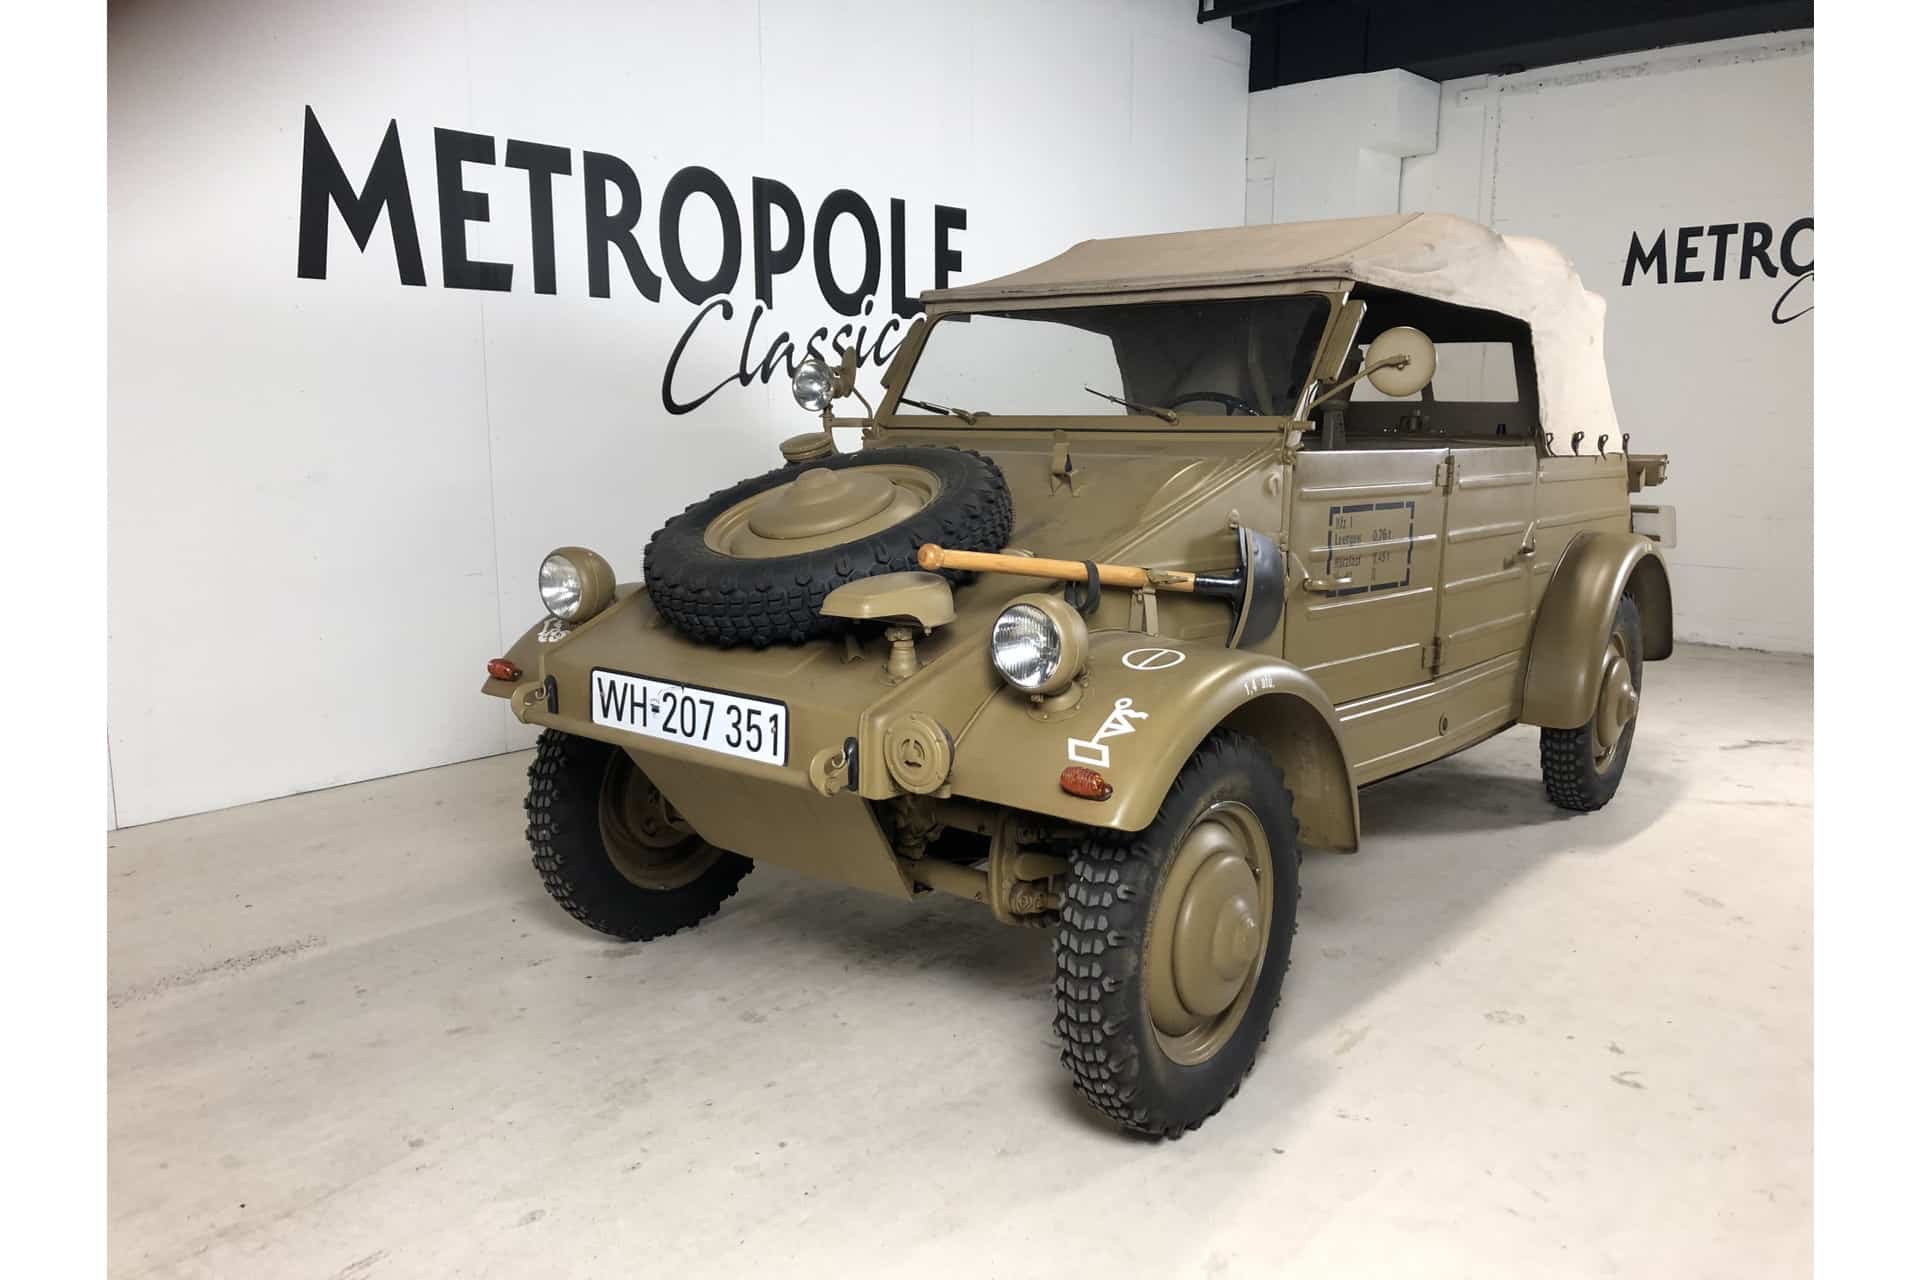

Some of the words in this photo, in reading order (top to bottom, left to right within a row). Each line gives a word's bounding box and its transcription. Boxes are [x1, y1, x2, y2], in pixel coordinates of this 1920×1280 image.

[297, 104, 970, 322] METROPOLE
[662, 297, 925, 415] Classic
[725, 704, 778, 757] 351
